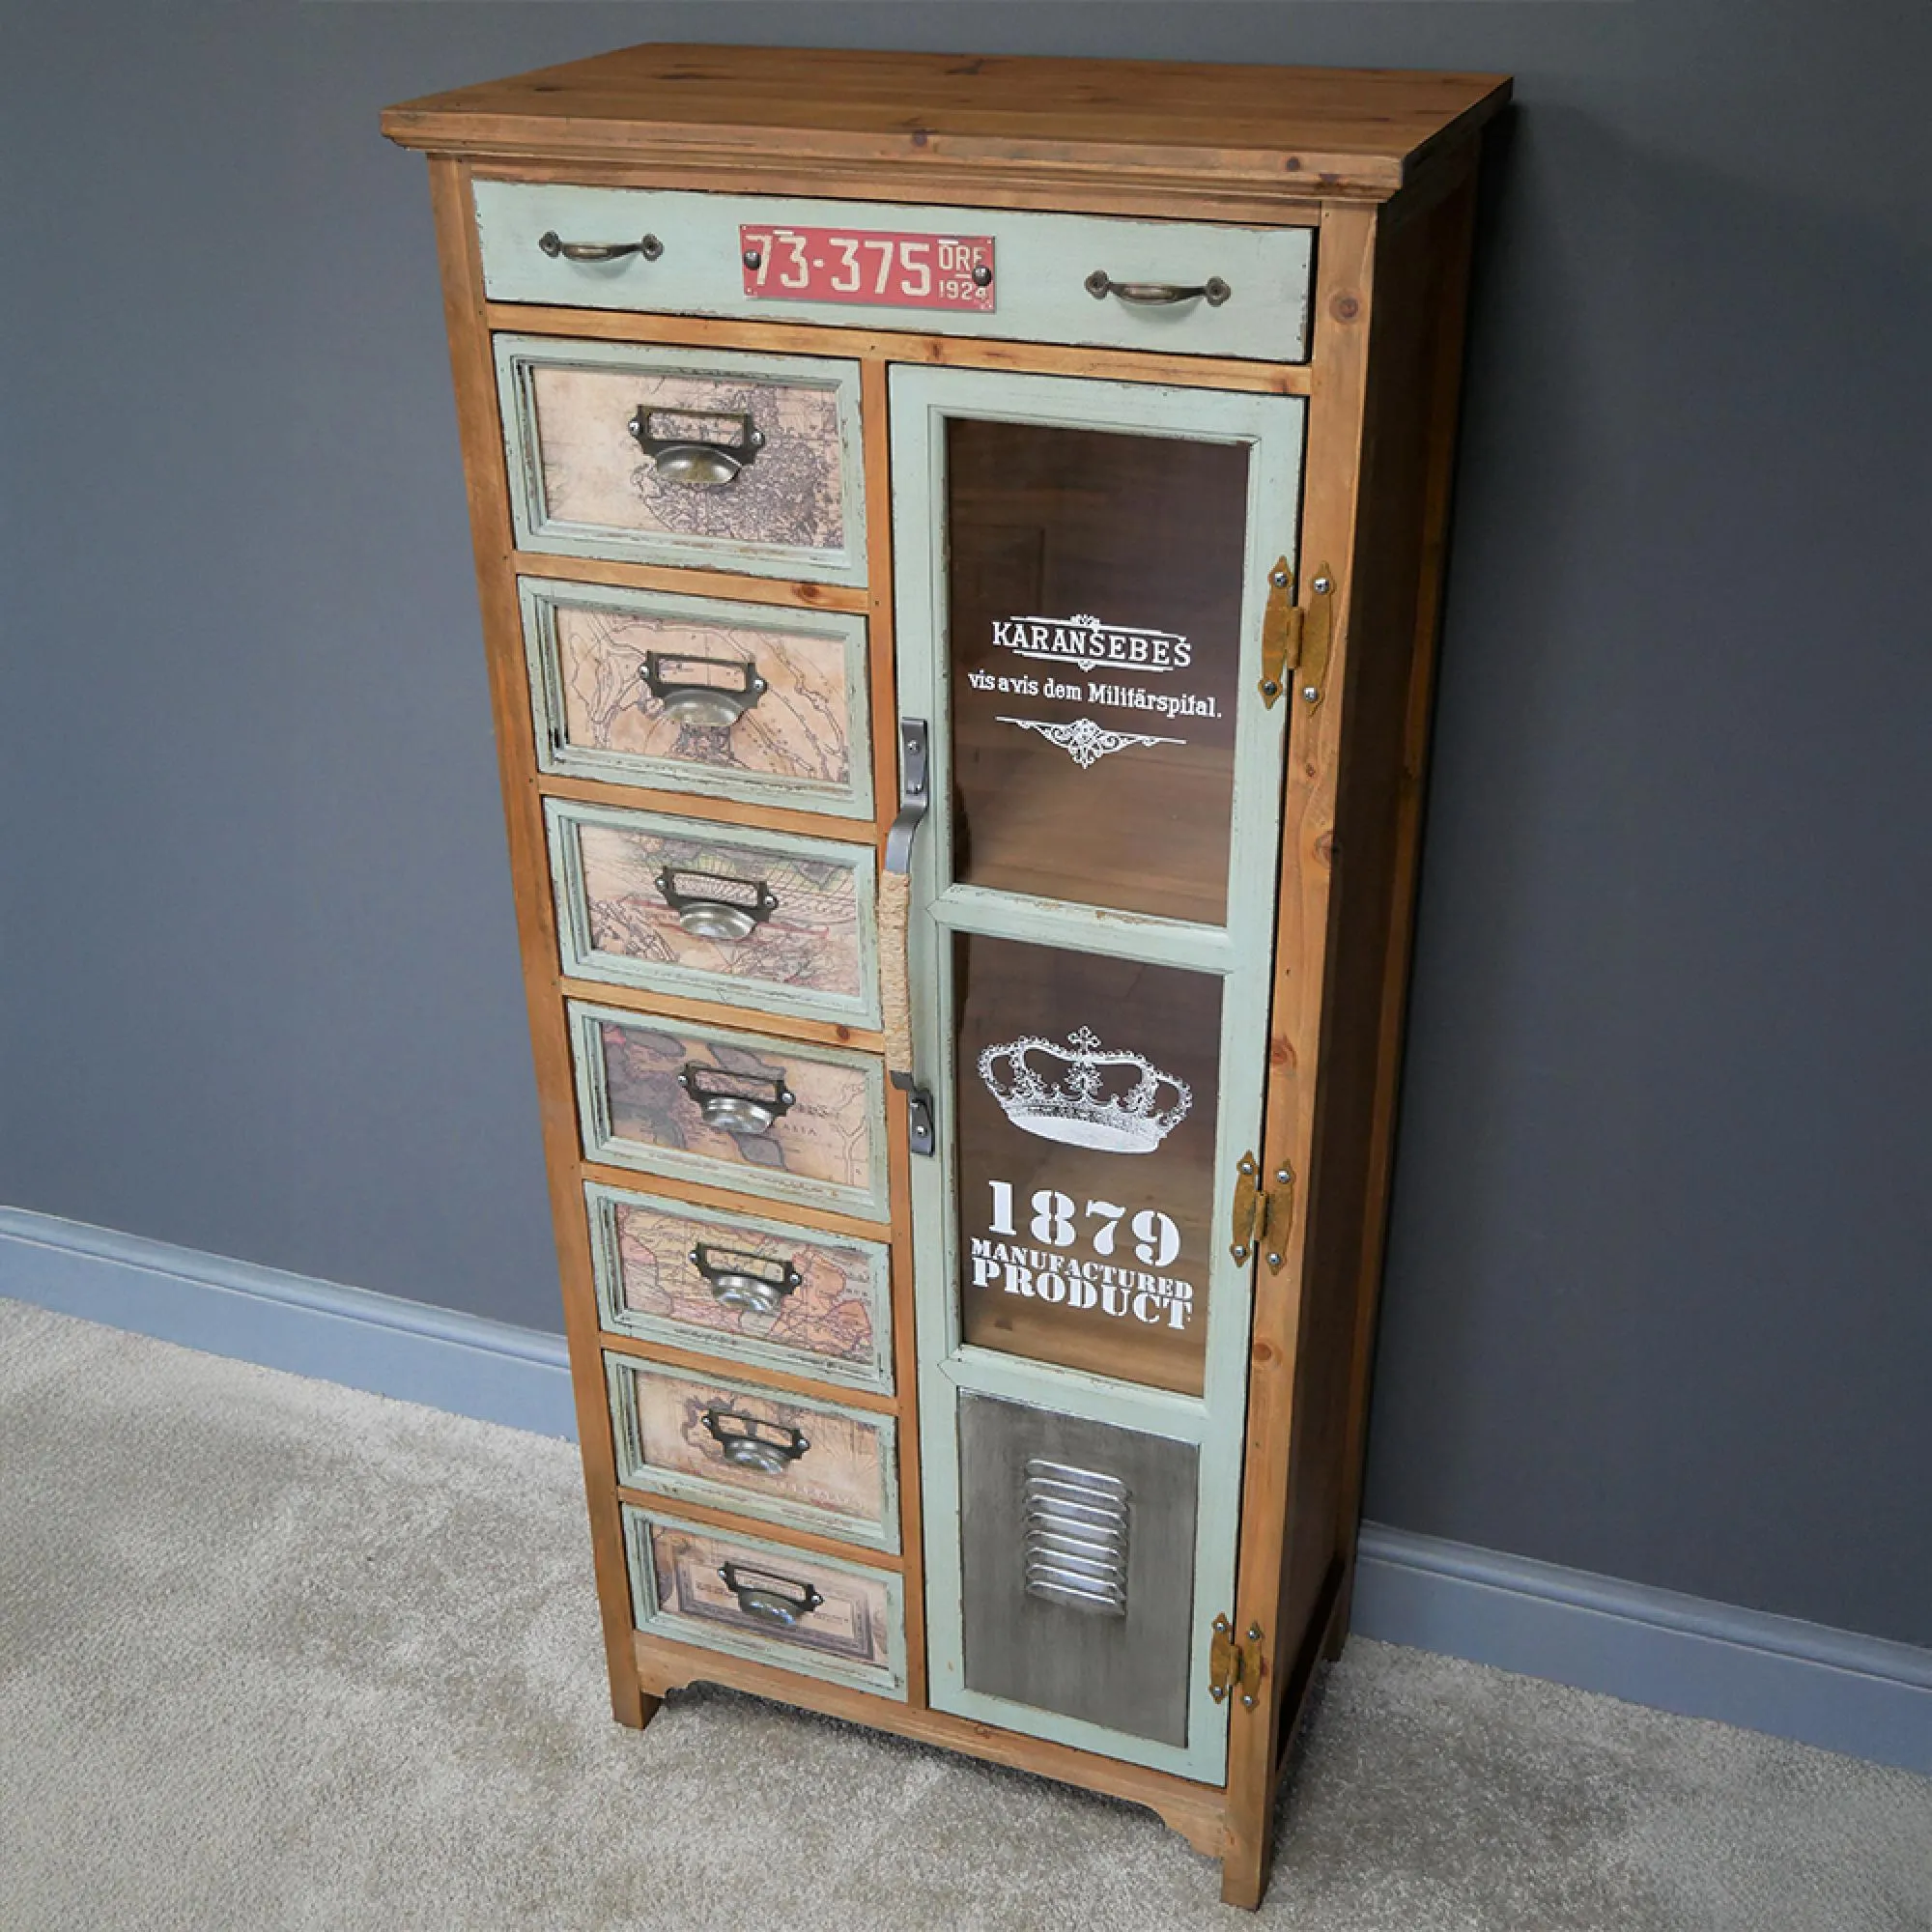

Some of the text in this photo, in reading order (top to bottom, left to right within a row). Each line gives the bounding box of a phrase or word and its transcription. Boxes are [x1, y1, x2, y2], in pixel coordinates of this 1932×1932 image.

[967, 668, 996, 692] vis
[1043, 677, 1083, 701] dem
[988, 1179, 1181, 1267] 1879
[970, 1236, 1194, 1300] MANUFACTURED
[972, 1257, 1194, 1330] PRODUCT
